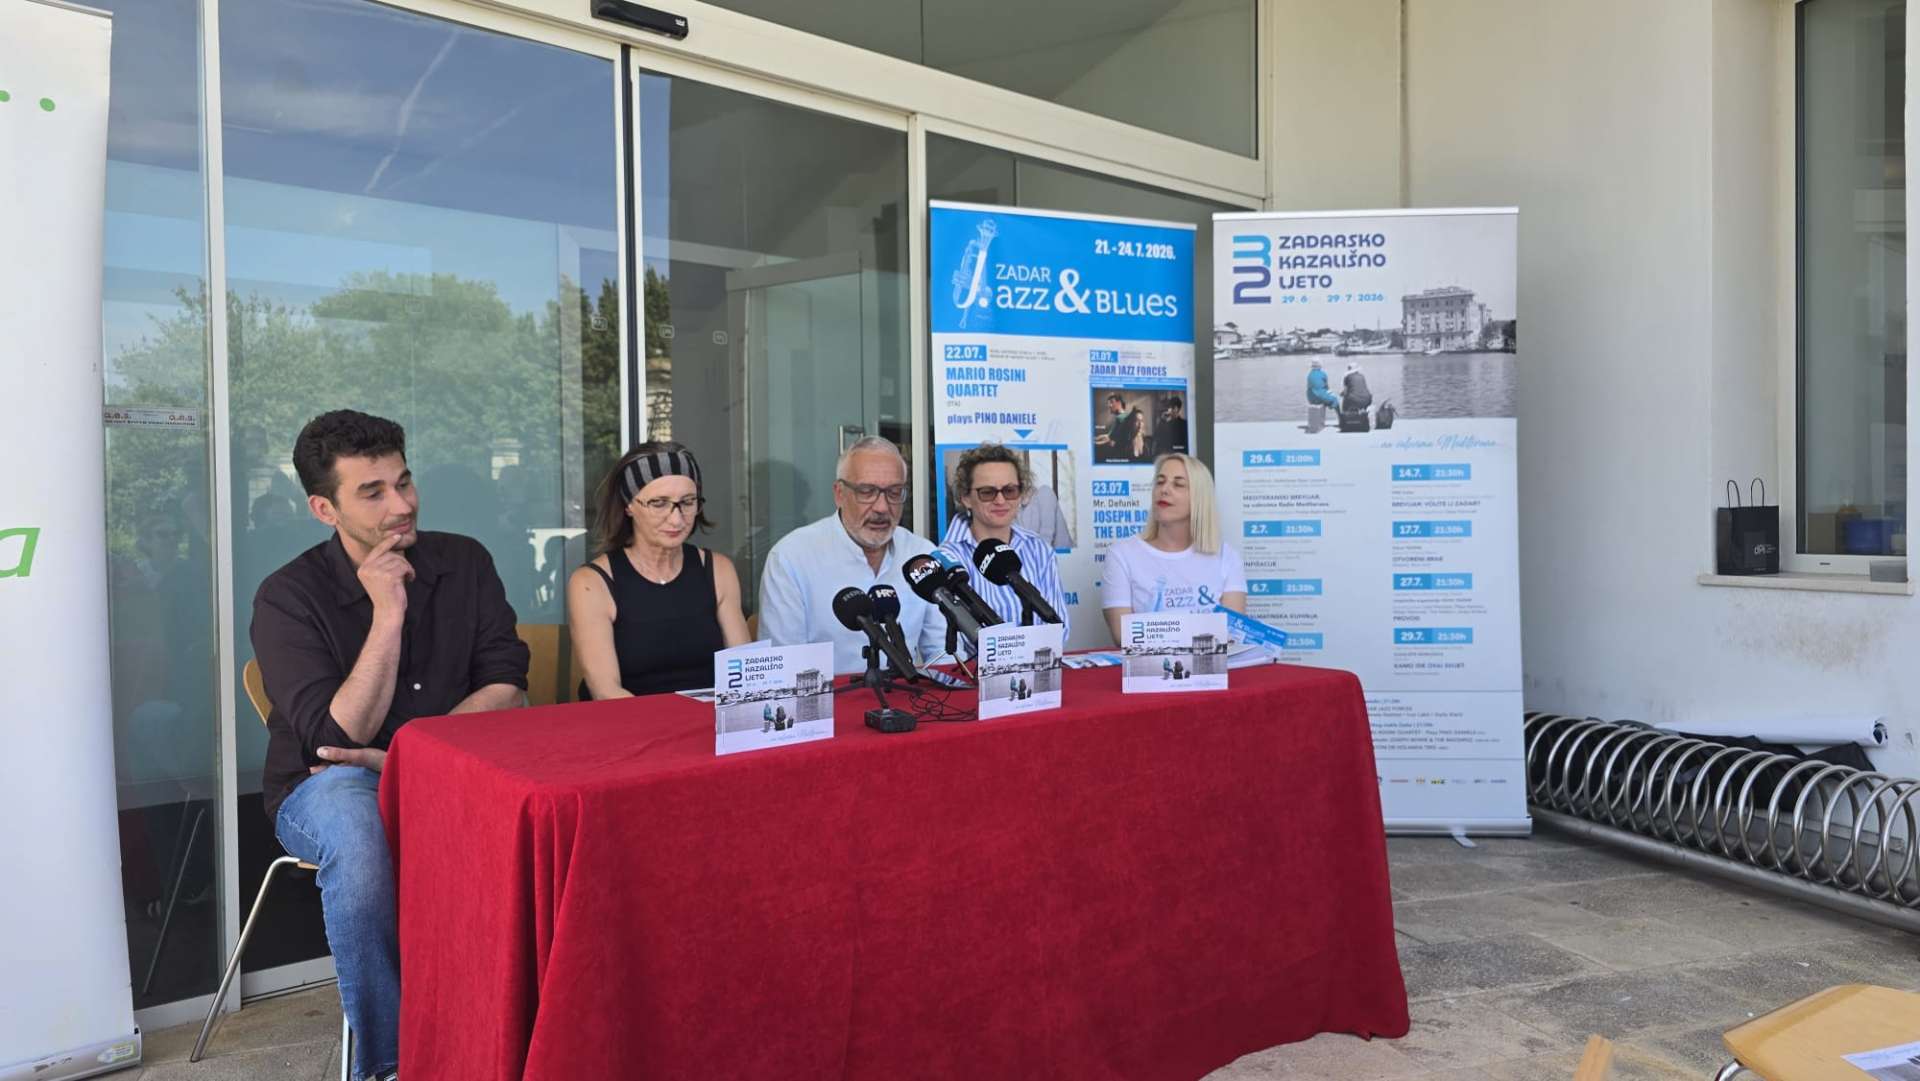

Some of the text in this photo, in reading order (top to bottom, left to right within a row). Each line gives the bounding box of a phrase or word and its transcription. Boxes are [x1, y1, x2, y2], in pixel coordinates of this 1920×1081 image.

[1279, 233, 1386, 249] ZADARSKO
[1279, 249, 1386, 269] KAZALIŠNO
[996, 264, 1051, 282] ZADAR
[1279, 274, 1333, 289] LJETO
[1054, 268, 1091, 314] &
[946, 346, 983, 359] 22.07.
[946, 367, 1026, 382] MARIO ROSINI
[1091, 364, 1167, 377] ZADAR JAZZ FORCES
[946, 383, 998, 398] QUARTET
[947, 412, 1037, 425] plays PINO DANIELE
[1399, 468, 1421, 478] 14.7.
[1094, 482, 1126, 494] 23.07.
[1093, 499, 1106, 508] Mr.
[1094, 510, 1148, 523] JOSEPH BO
[1094, 525, 1145, 539] THE BAST
[1250, 524, 1268, 535] 2.7.
[1399, 524, 1421, 535] 17.7.
[1251, 583, 1269, 593] 6.7.
[1400, 576, 1423, 587] 27.7.
[1064, 592, 1079, 605] DA
[1198, 584, 1216, 606] &
[1400, 631, 1425, 642] 29.7.
